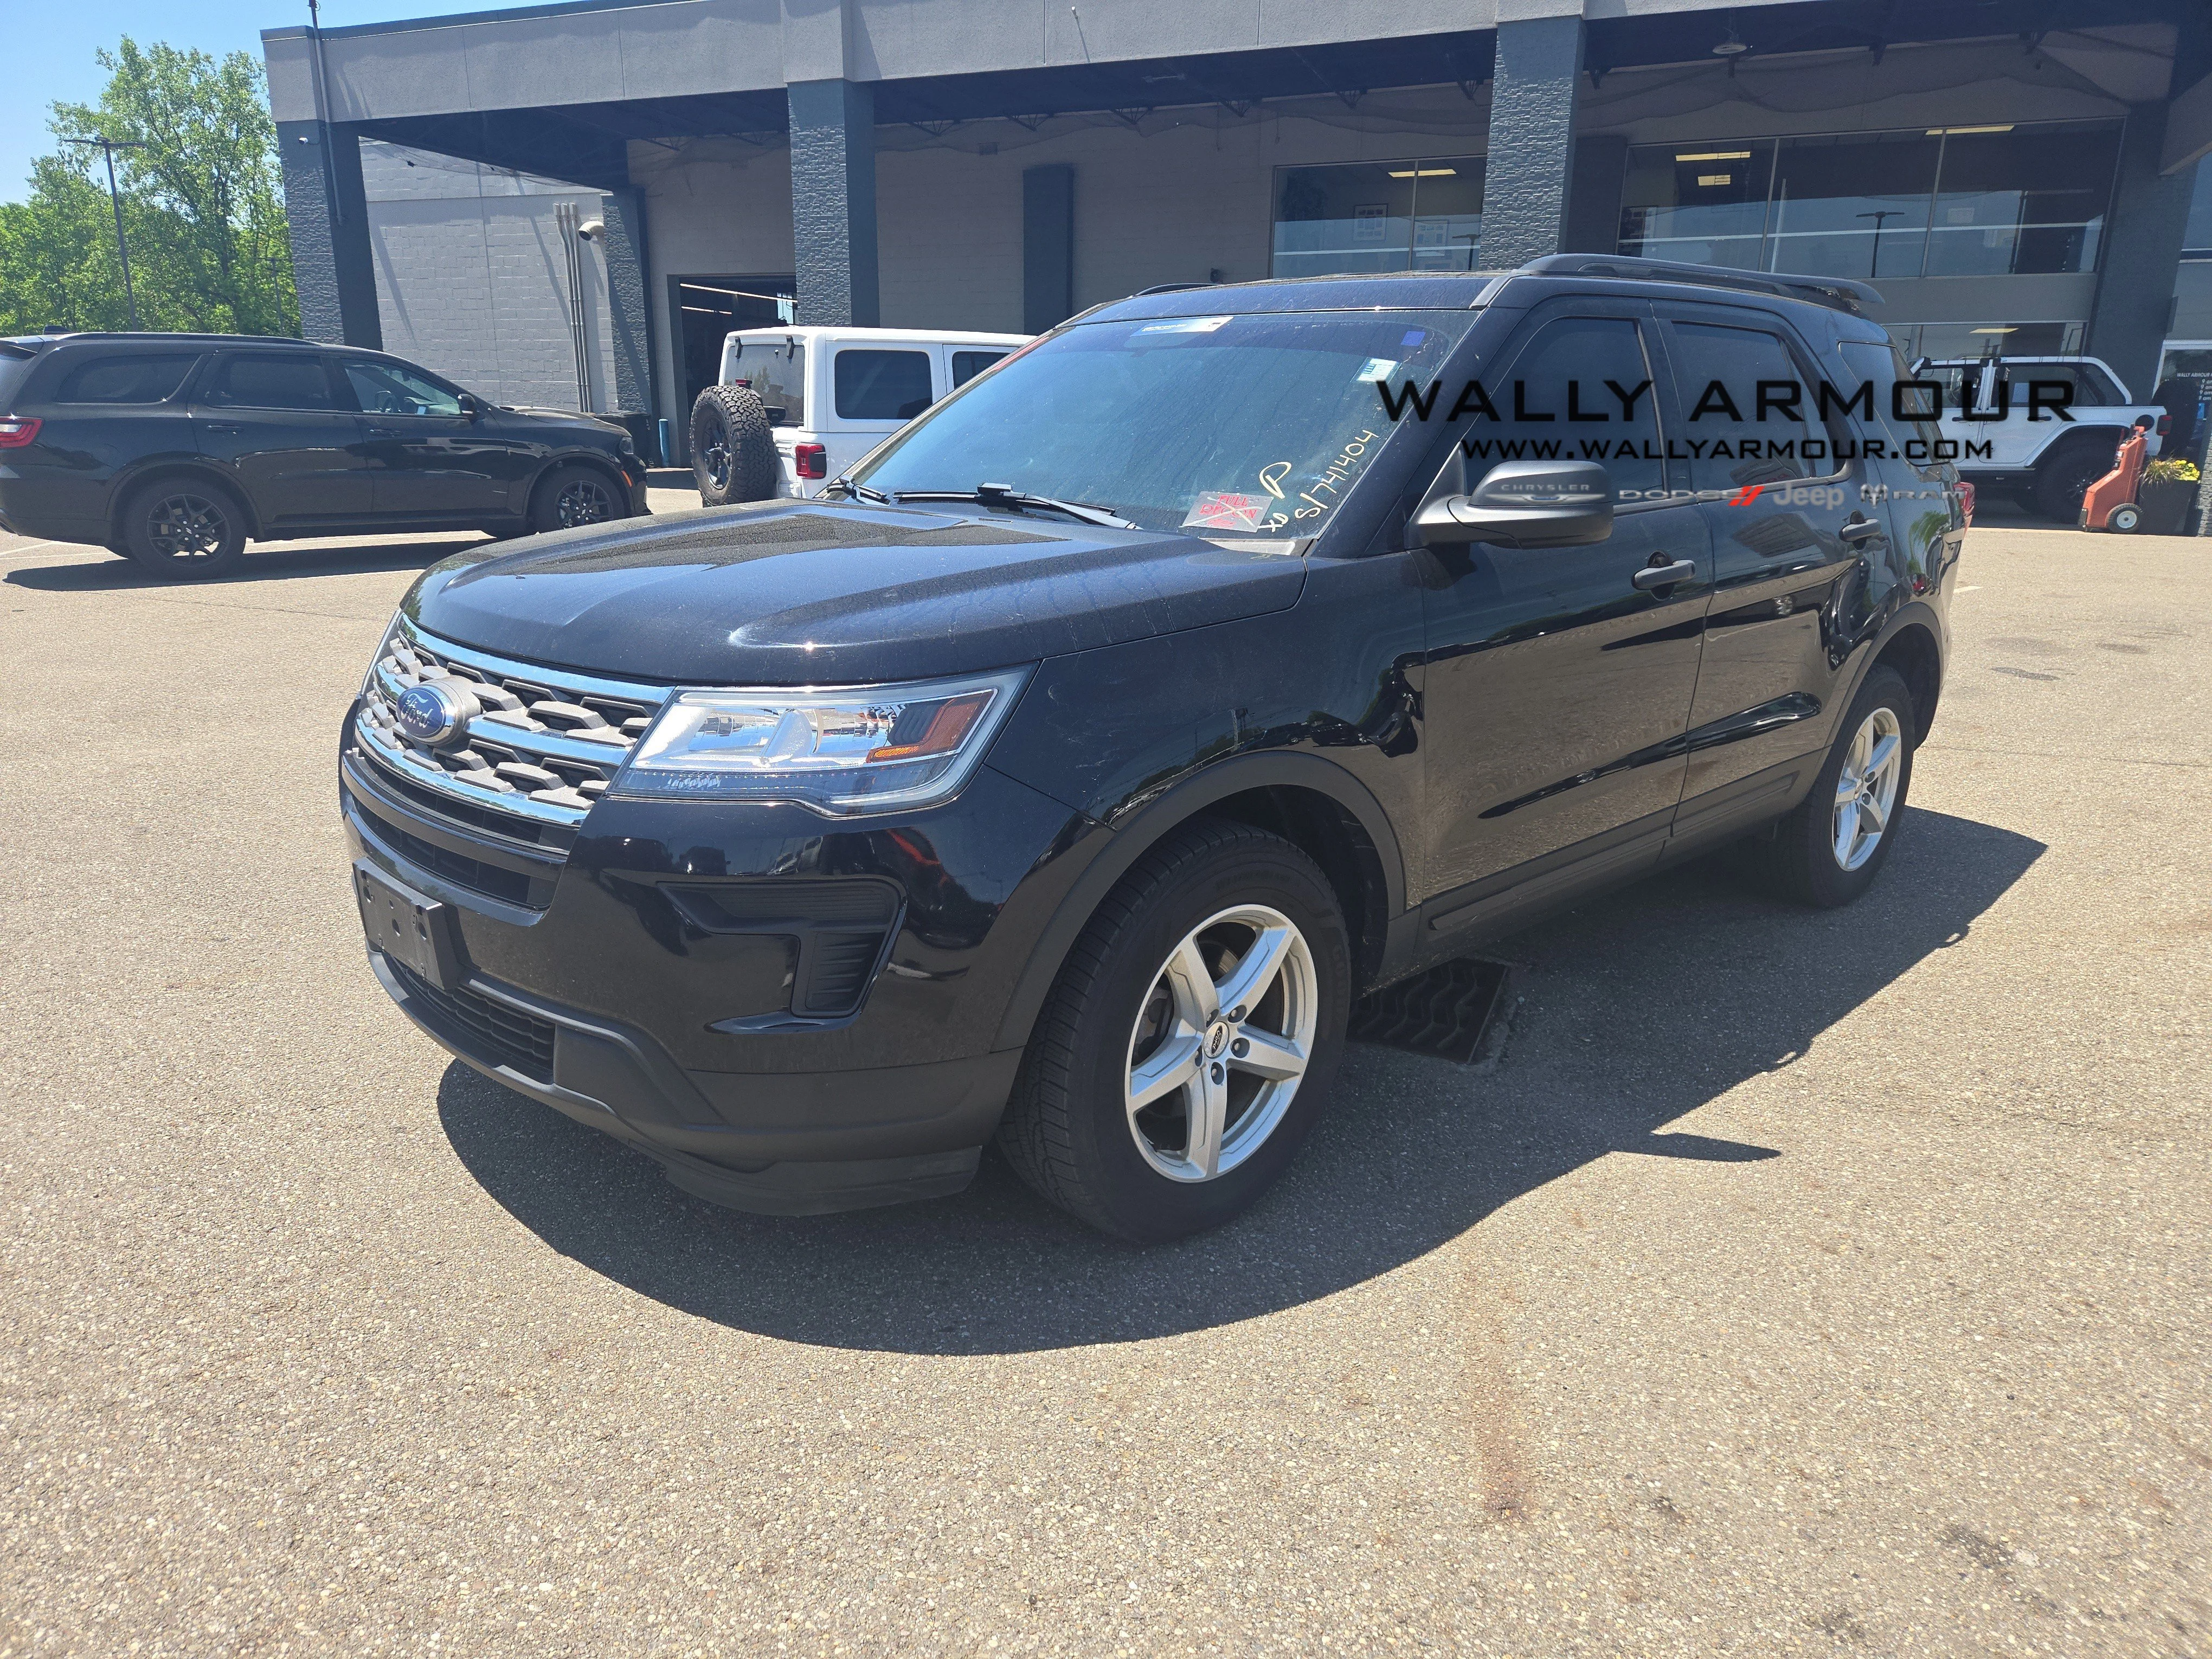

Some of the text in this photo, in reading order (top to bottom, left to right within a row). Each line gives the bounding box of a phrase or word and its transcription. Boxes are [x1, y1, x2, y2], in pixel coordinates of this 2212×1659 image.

[1217, 494, 1249, 506] FULL
[401, 693, 434, 728] Ford
[1212, 1030, 1221, 1050] Ford
